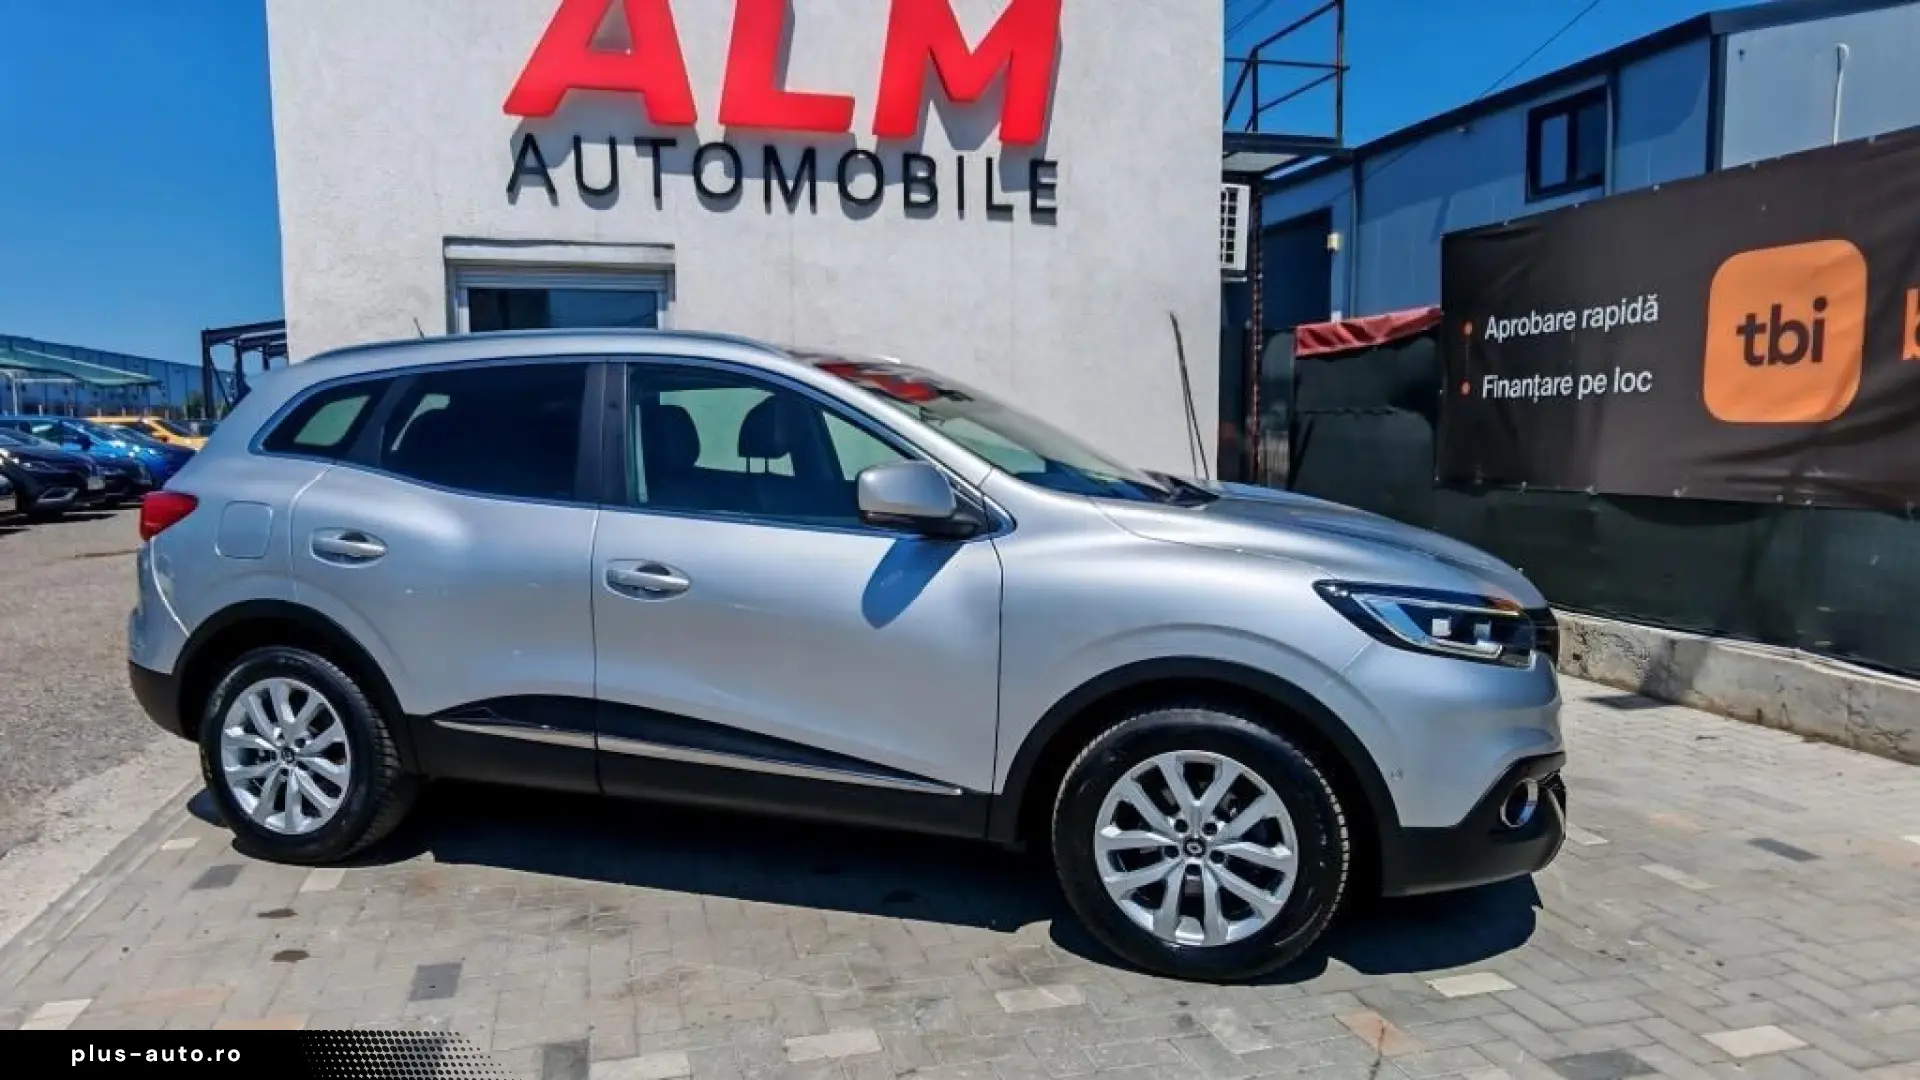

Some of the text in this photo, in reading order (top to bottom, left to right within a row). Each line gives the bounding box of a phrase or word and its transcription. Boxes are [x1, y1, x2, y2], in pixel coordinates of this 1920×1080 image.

[503, 0, 1062, 145] ALM
[506, 132, 1059, 221] AUTOMOBILE
[1484, 293, 1658, 343] Aprobare rapidă
[1736, 297, 1828, 366] tbi
[1482, 365, 1653, 403] Finanțare pe loc
